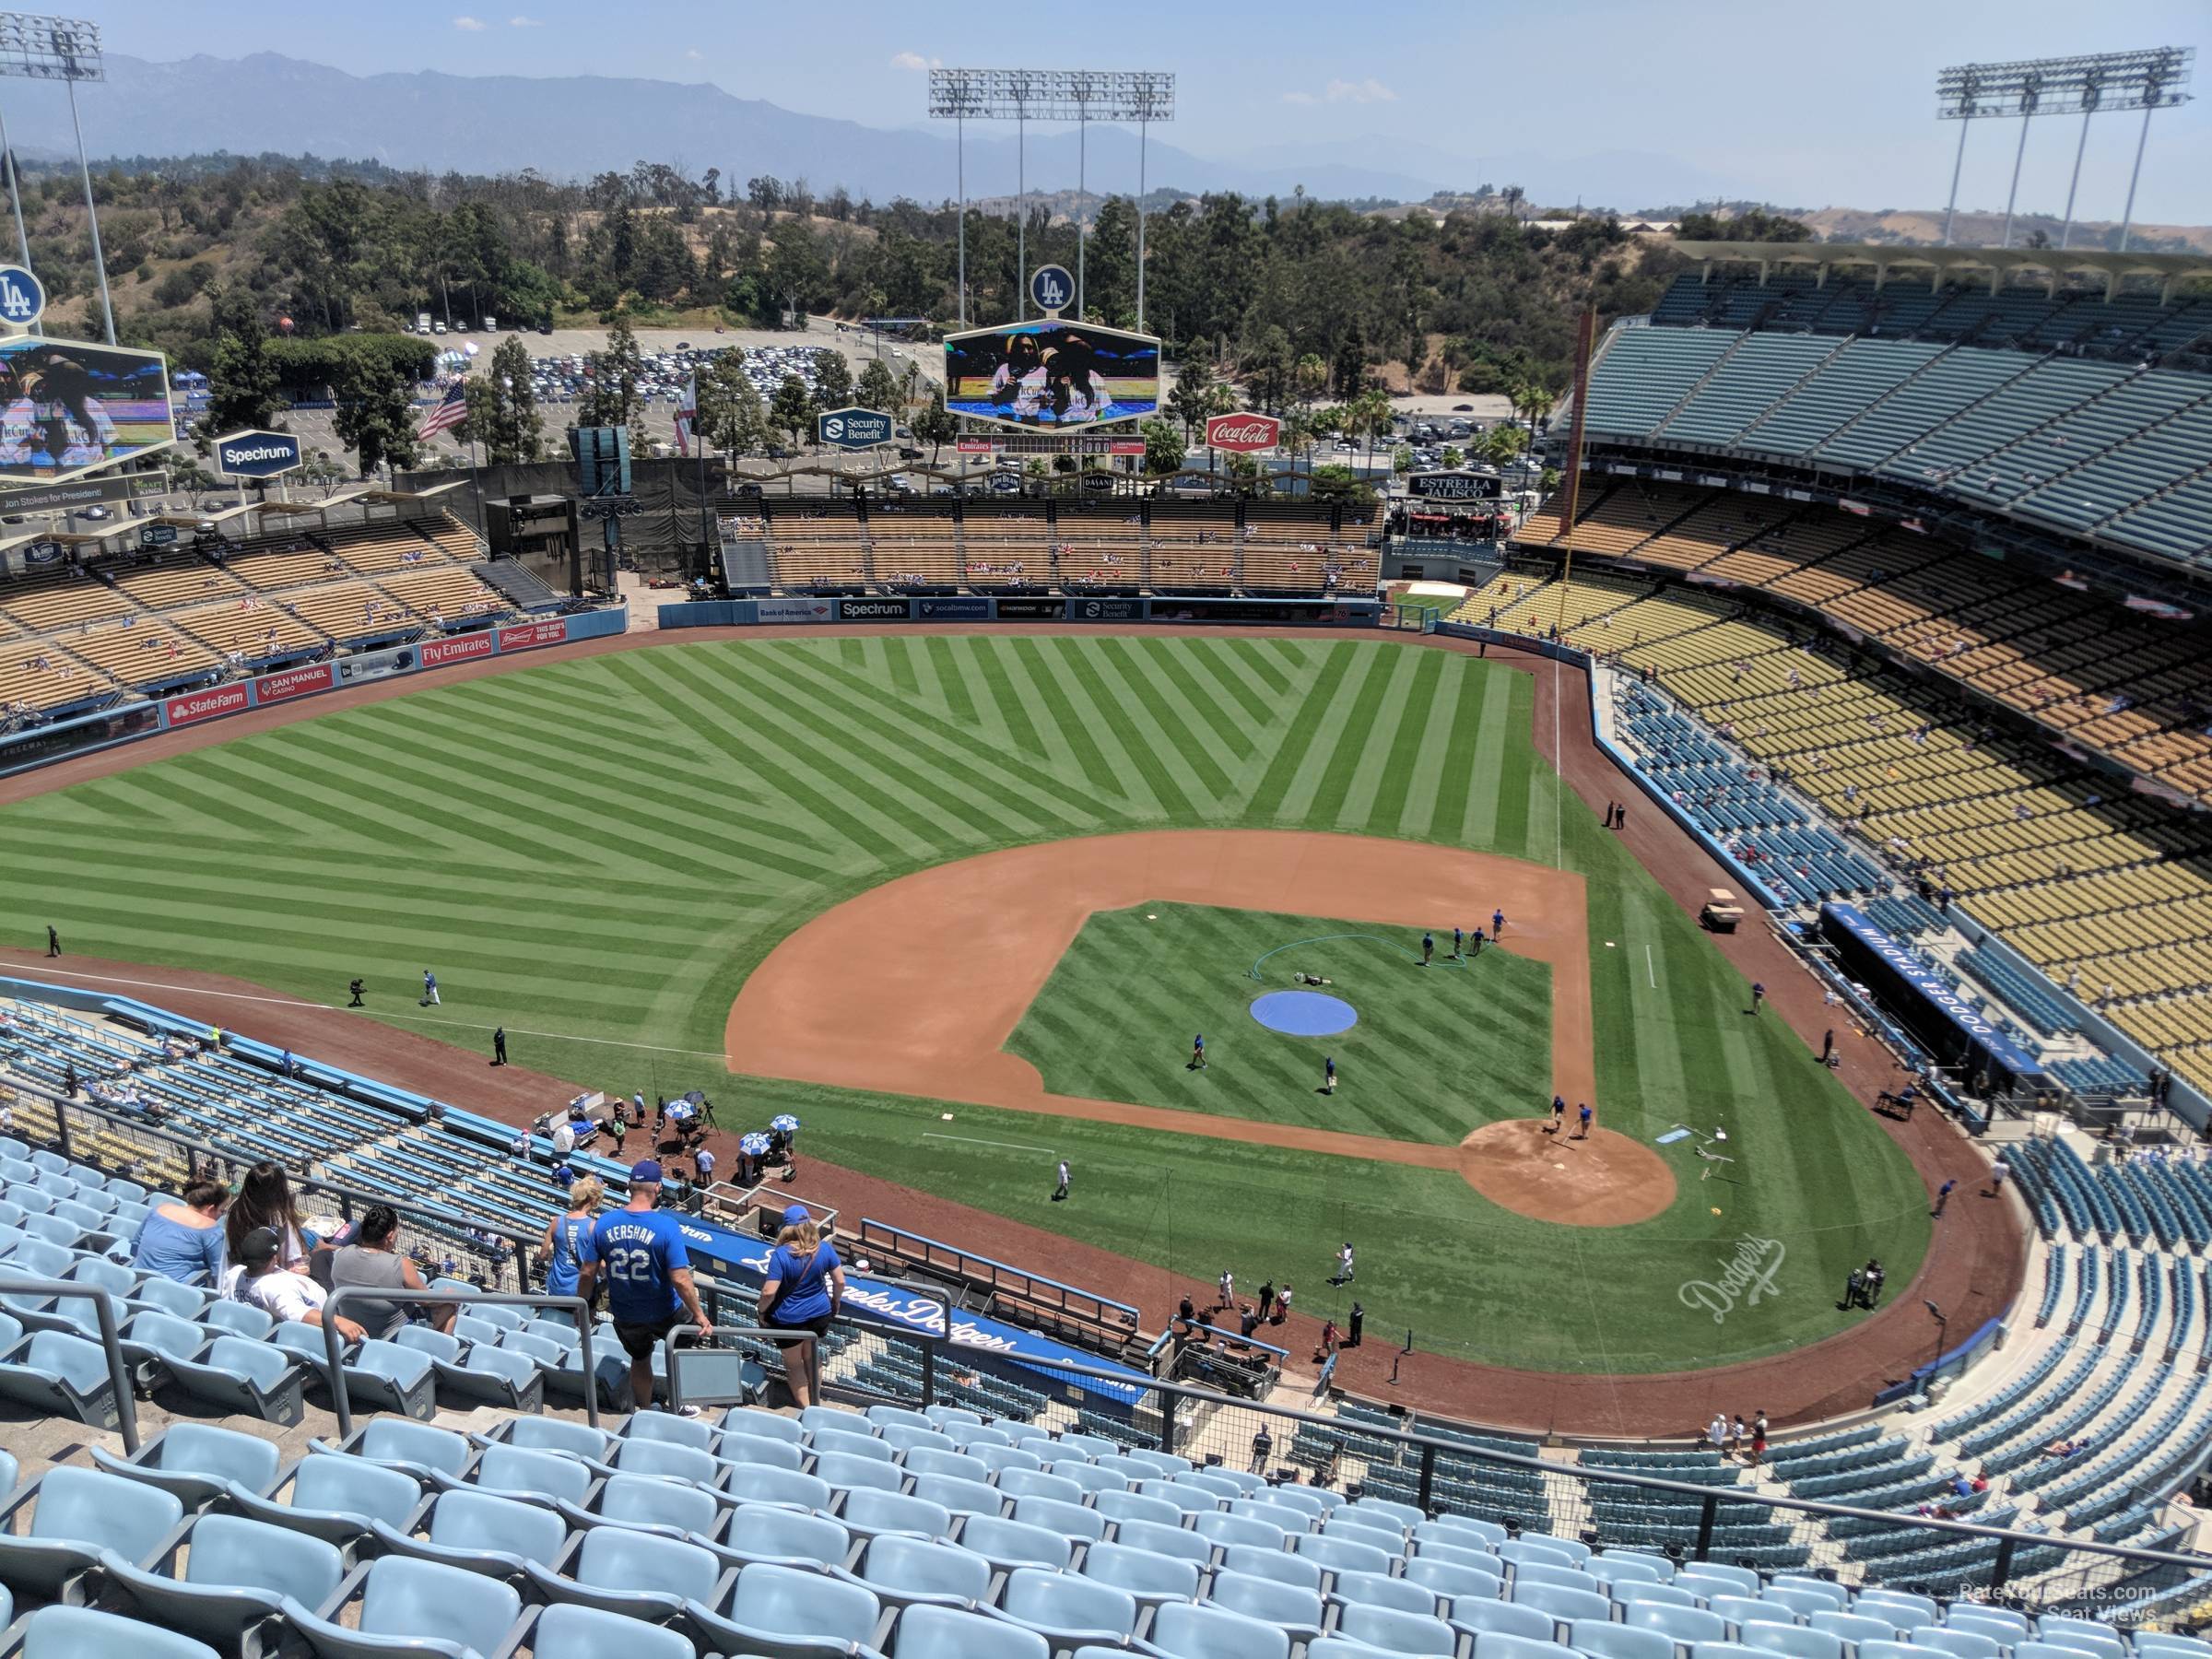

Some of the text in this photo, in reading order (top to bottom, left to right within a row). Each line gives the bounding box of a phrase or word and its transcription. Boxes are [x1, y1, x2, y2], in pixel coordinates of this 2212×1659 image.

[1041, 272, 1064, 305] LA
[0, 276, 32, 317] LA
[847, 418, 886, 430] Security
[848, 429, 881, 440] Benefit
[1212, 422, 1273, 443] Coca-Cola
[226, 446, 290, 465] Spectrum
[1085, 478, 1112, 488] DASANI
[1419, 478, 1491, 489] ESTRELLA
[5, 488, 102, 508] Jon Stokes for President!
[1425, 488, 1484, 499] JALISCO
[154, 528, 174, 537] Security
[155, 534, 172, 542] Benefit
[777, 608, 784, 617] of
[785, 608, 811, 617] America
[843, 603, 902, 617] Spectrum
[1102, 602, 1133, 612] Security
[535, 625, 548, 634] THIS
[536, 632, 547, 641] FOR
[423, 638, 490, 661] Fly Emirates
[271, 669, 327, 688] SAN MANUEL
[272, 686, 295, 695] CASINO
[1860, 928, 1993, 1033] DODGER STADIUM
[606, 1224, 656, 1245] KERSHAW
[608, 1247, 651, 1281] 22
[1678, 1232, 1786, 1324] Dodgers
[890, 1299, 1018, 1351] Dodgers
